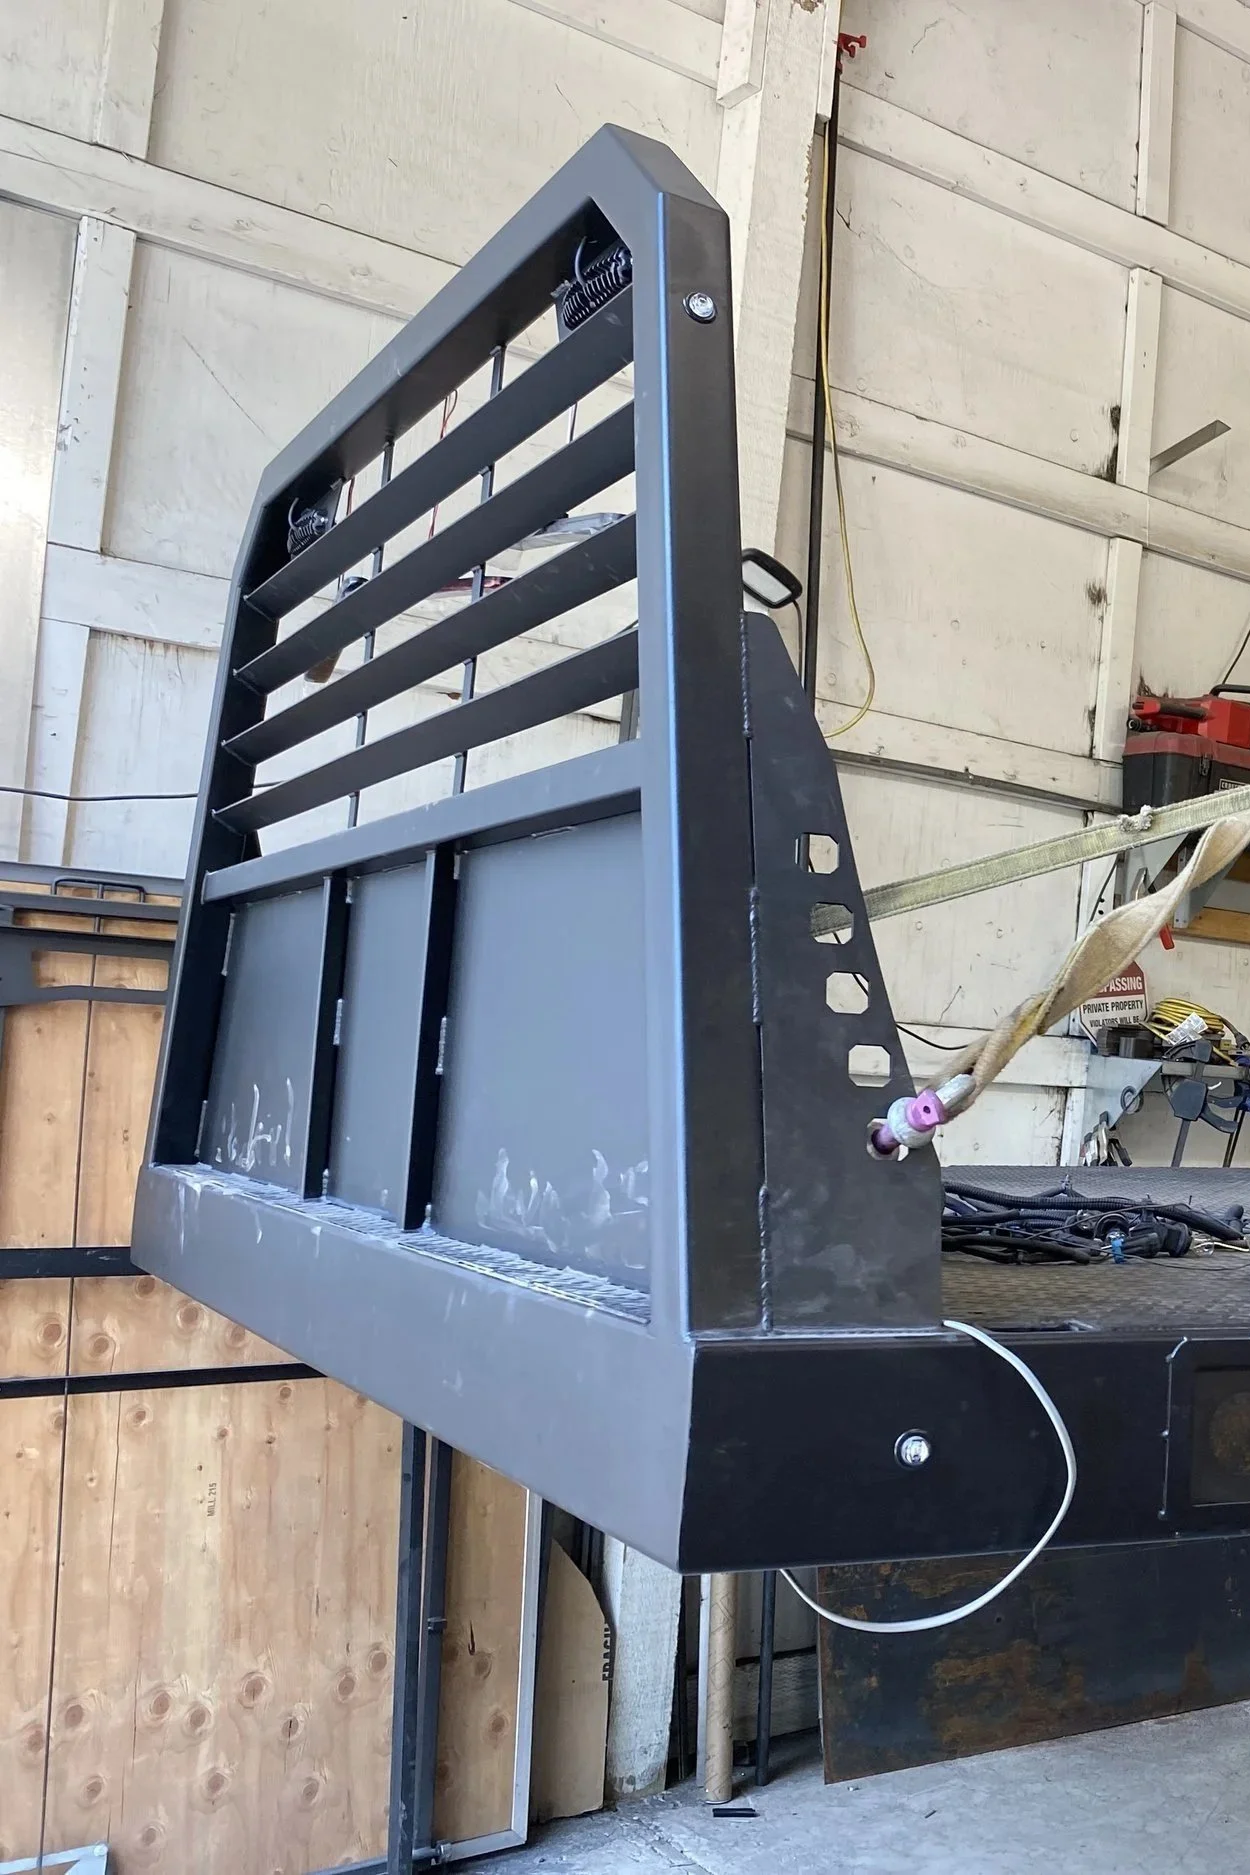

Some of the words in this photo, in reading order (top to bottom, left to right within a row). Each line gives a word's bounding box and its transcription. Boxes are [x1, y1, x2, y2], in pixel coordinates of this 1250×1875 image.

[1099, 976, 1143, 992] PASSING
[1082, 1002, 1109, 1014] PRIVATE
[1111, 1000, 1144, 1012] PROPERTY
[1089, 1018, 1119, 1028] VIOLATORS
[1119, 1016, 1131, 1026] WILL
[1133, 1015, 1140, 1024] BE
